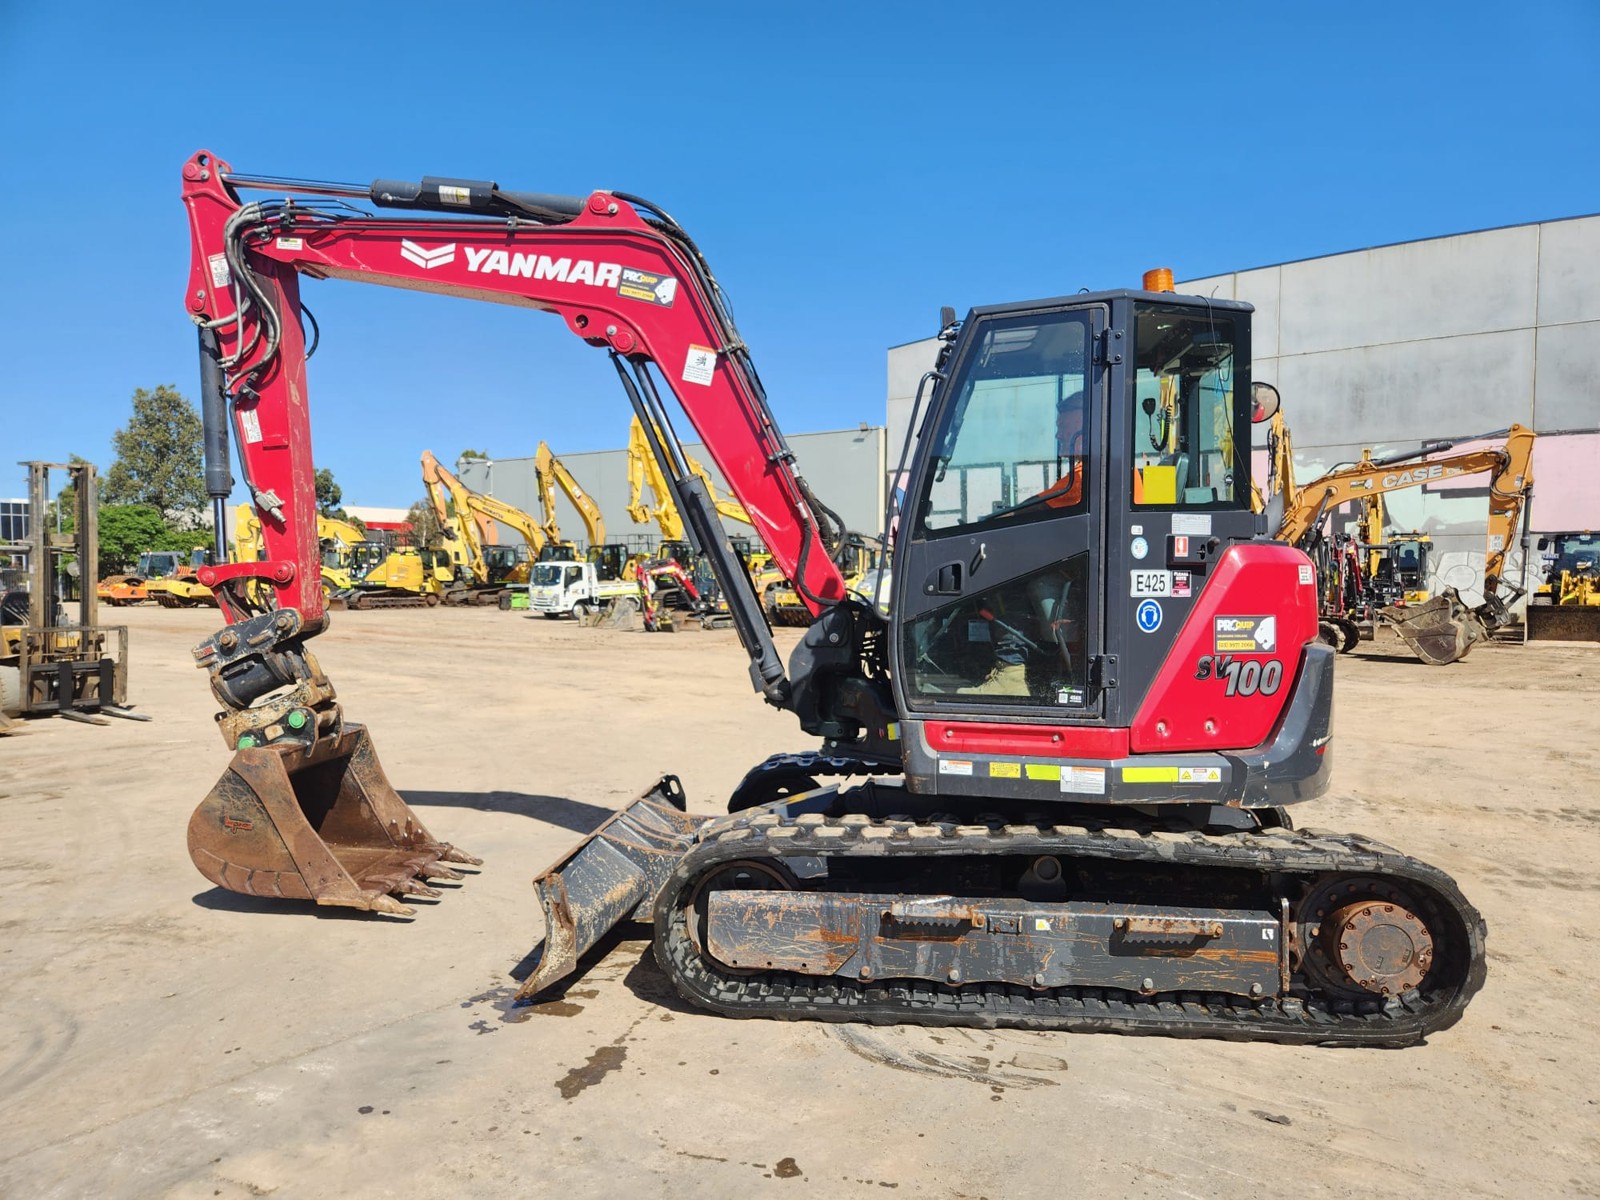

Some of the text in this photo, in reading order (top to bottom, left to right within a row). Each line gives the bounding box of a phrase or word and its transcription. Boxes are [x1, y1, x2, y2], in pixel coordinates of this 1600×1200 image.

[464, 247, 622, 289] YANMAR
[622, 269, 658, 284] PROQUIP
[1382, 464, 1443, 489] CASE
[1136, 574, 1166, 592] E425
[1217, 619, 1255, 631] PROQUIP
